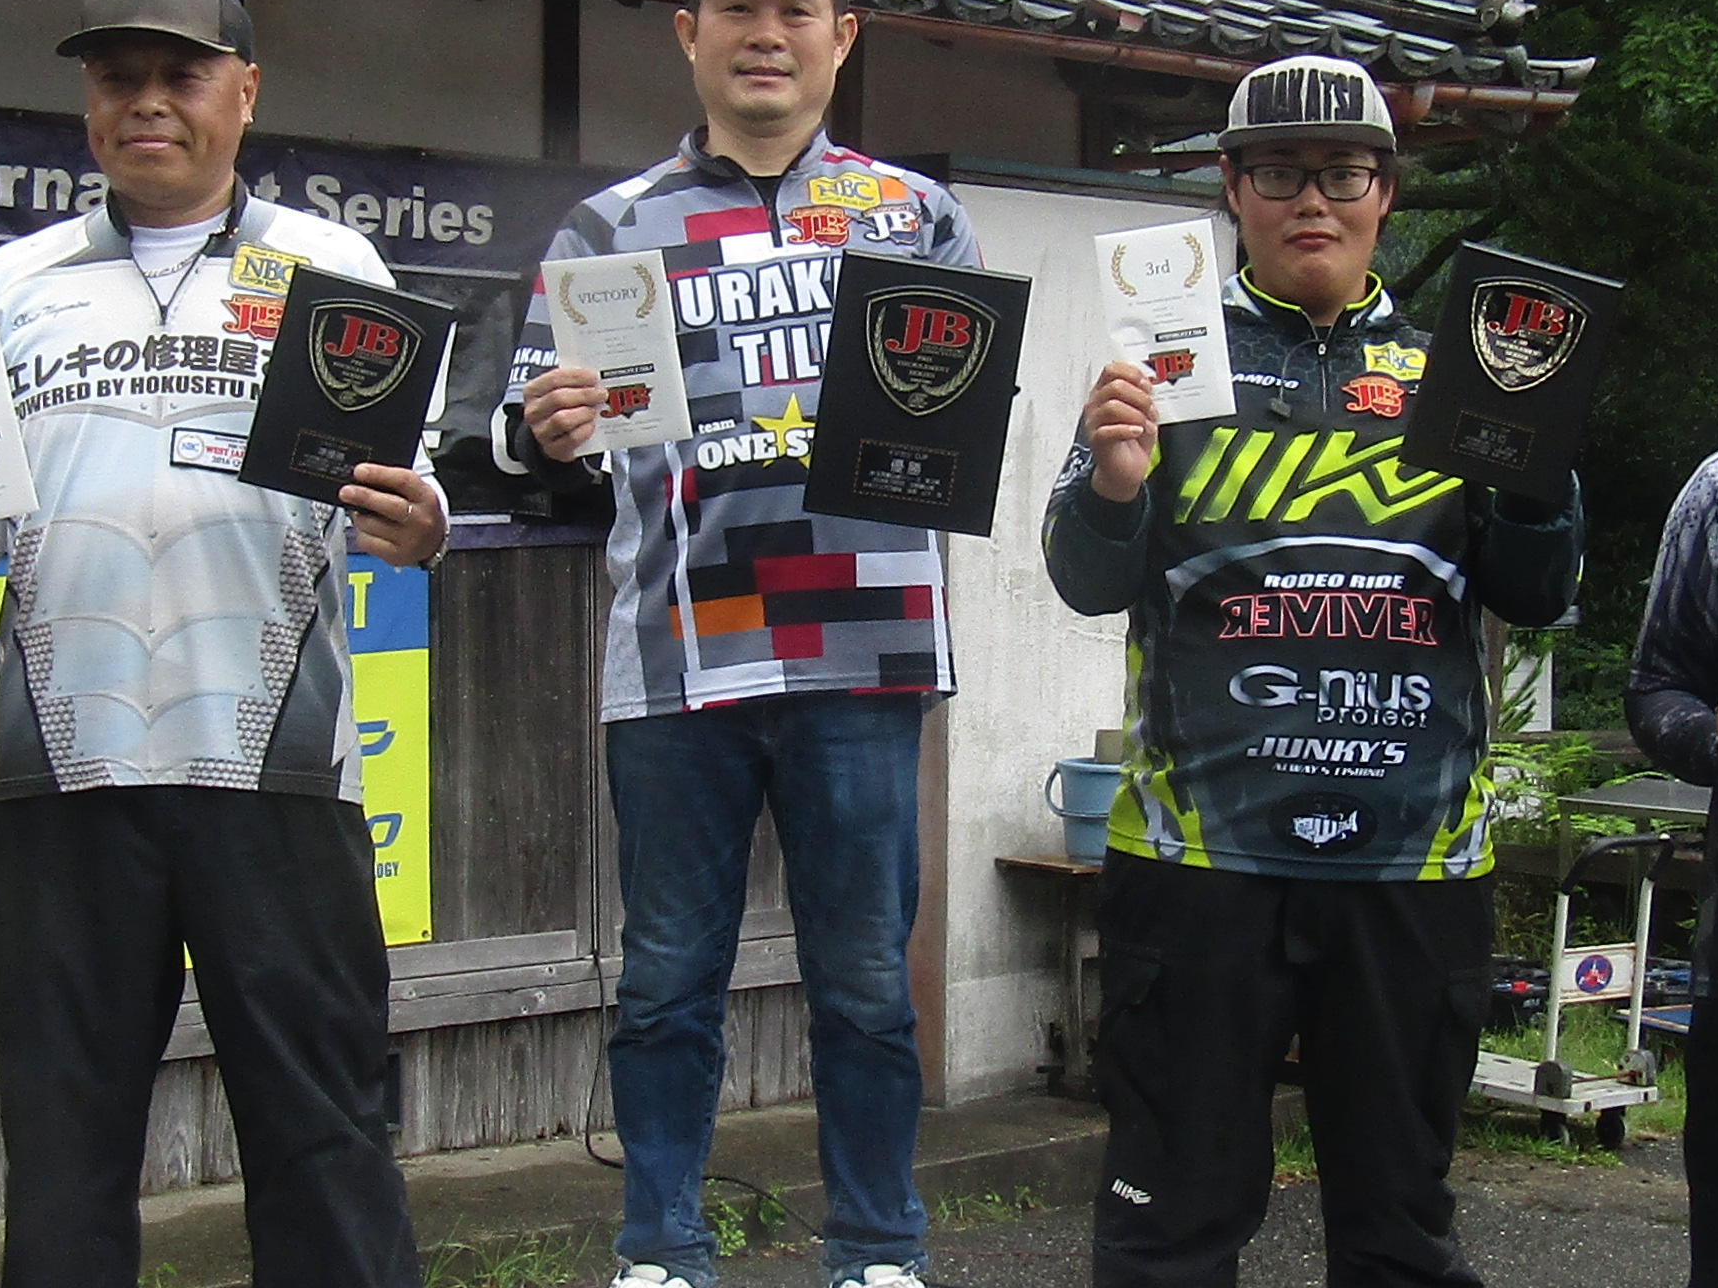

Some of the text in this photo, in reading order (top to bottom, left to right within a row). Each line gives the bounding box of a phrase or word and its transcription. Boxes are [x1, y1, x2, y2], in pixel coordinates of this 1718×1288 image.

[306, 174, 494, 245] Series
[1146, 259, 1171, 277] 3rd
[578, 287, 639, 305] VICTORY
[1486, 292, 1567, 336] JB
[324, 314, 401, 358] JB
[884, 304, 971, 354] JB
[97, 378, 125, 398] BY
[131, 375, 245, 399] HOKUSETU
[699, 418, 736, 434] team
[697, 431, 778, 470] ONE
[1264, 572, 1406, 591] RODEO RIDE
[1317, 705, 1428, 729] project
[1246, 736, 1409, 765] JUNKY'S
